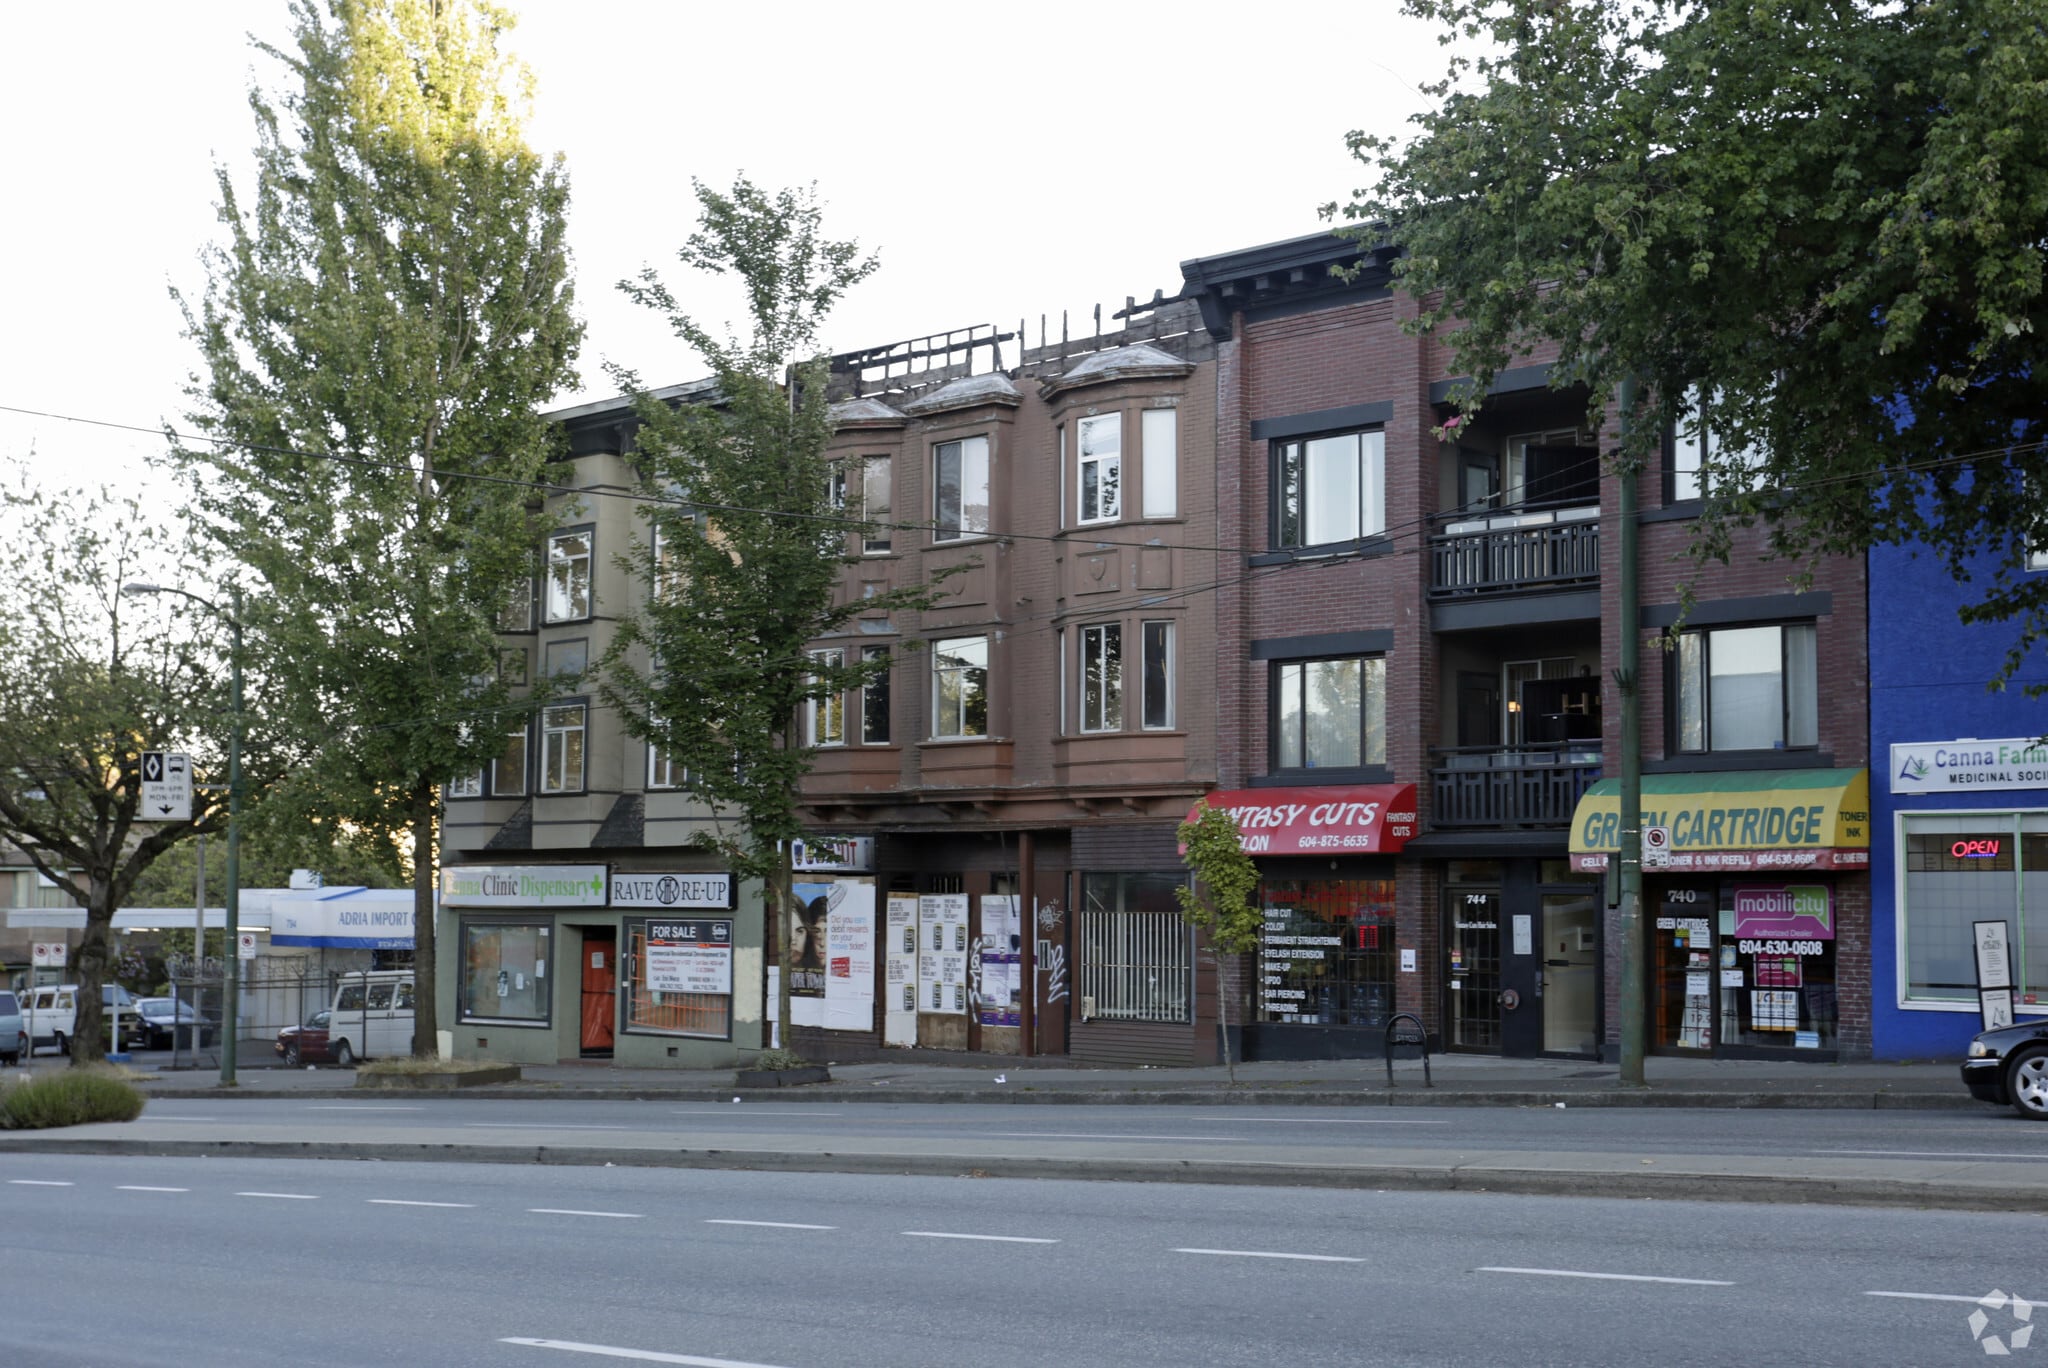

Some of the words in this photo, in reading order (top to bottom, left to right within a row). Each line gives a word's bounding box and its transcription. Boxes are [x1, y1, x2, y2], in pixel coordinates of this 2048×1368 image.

[1935, 749, 1994, 768] Canna
[1949, 771, 2013, 784] MEDICINAL
[2018, 770, 2048, 782] SOCI
[1308, 802, 1380, 826] CUTS
[1386, 812, 1417, 823] FANTASY
[1839, 811, 1868, 822] TONER
[1392, 826, 1411, 837] CUTS
[1672, 805, 1824, 847] CARTRIDGE
[1846, 827, 1861, 838] INK
[1299, 835, 1368, 848] 604-875-6635
[1951, 840, 2000, 858] OPEN
[1581, 857, 1601, 867] CELL
[1670, 855, 1692, 866] ONER
[1695, 855, 1702, 865] &
[1704, 855, 1720, 865] INK
[1721, 854, 1751, 865] REFILL
[1756, 853, 1817, 864] 604-630-0608
[482, 874, 518, 897] Clinic
[520, 875, 590, 903] Dispensary
[614, 881, 654, 901] RAVE
[681, 881, 727, 901] RE-UP
[1466, 894, 1487, 904] 744
[1667, 890, 1697, 903] 740
[1740, 893, 1825, 916] mobilicity
[338, 911, 368, 926] ADRIA
[371, 911, 408, 926] IMPORT
[1264, 908, 1279, 918] HAIR
[1279, 908, 1292, 918] CUT
[1264, 922, 1286, 931] COLOR
[1656, 917, 1676, 929] GREEN
[1676, 917, 1709, 930] CARTRIDGE
[652, 926, 671, 938] FOR
[671, 926, 697, 939] SALE
[1753, 929, 1790, 937] Authorized
[1790, 929, 1813, 937] Dealer
[1264, 935, 1297, 945] PERMANENT
[1297, 936, 1342, 946] STRAIGHTENING
[1739, 940, 1823, 955] 604-630-0608
[1264, 949, 1291, 958] EYELASH
[1291, 949, 1325, 959] EXTENSION
[1264, 962, 1291, 972] MAKE-UP
[1264, 975, 1281, 985] UPDO
[1264, 989, 1277, 998] EAR
[1277, 989, 1306, 999] PIERCING
[1264, 1002, 1299, 1012] THREADING
